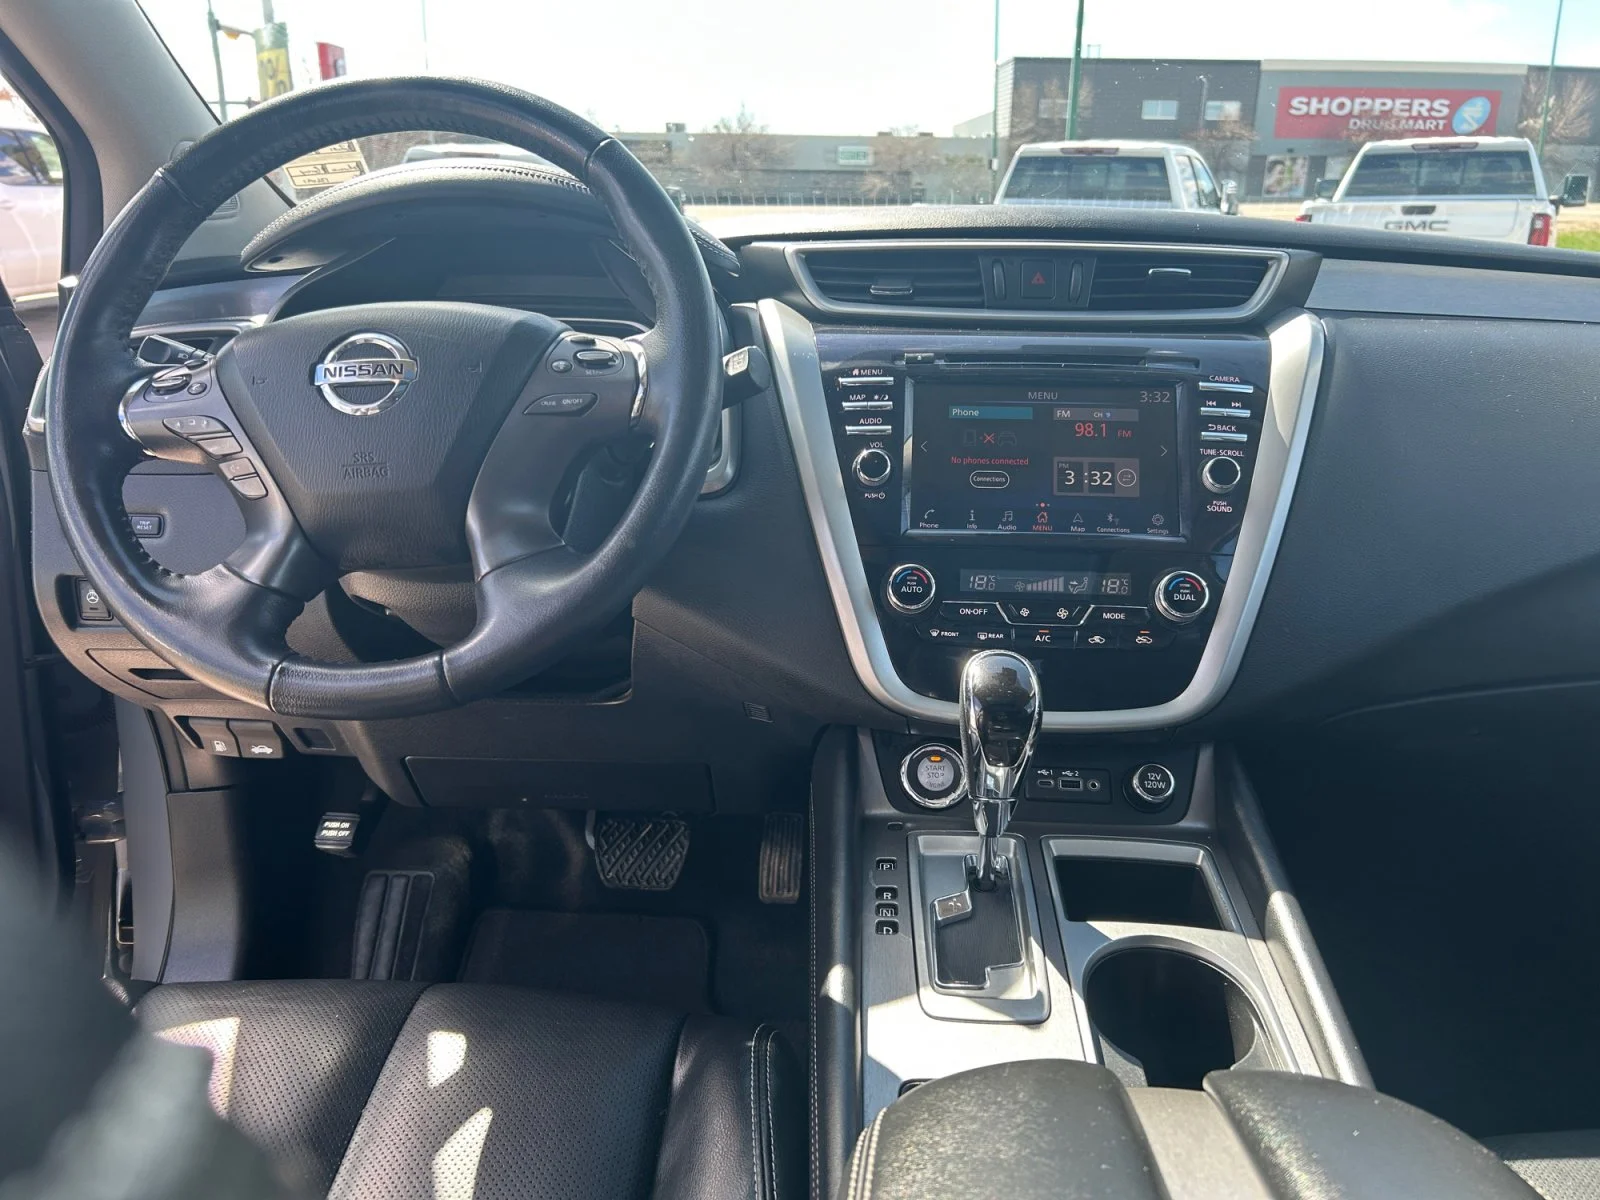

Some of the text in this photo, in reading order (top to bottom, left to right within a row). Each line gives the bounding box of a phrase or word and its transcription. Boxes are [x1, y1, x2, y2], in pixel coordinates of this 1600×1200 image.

[1288, 96, 1451, 118] SHOPPERS
[1399, 119, 1447, 130] MART
[1384, 220, 1450, 232] GMC
[323, 363, 404, 379] NISSAN
[1209, 375, 1240, 383] CAMERA
[1028, 391, 1058, 400] MENU
[1140, 390, 1171, 403] 3:32
[952, 408, 980, 417] Phone
[1056, 410, 1071, 418] FM
[1075, 422, 1132, 438] 98.1 FM
[1216, 424, 1237, 432] BACK
[353, 452, 375, 463] SRS
[951, 456, 1029, 465] No phones connected
[343, 467, 389, 480] AIRBAG
[1206, 505, 1233, 513] SOUND
[1146, 527, 1169, 535] Settings
[900, 585, 923, 593] AUTO
[1173, 593, 1196, 601] DUAL
[1102, 612, 1126, 620] MODE
[1143, 781, 1166, 789] 120W
[883, 892, 892, 900] R
[883, 927, 893, 935] D
